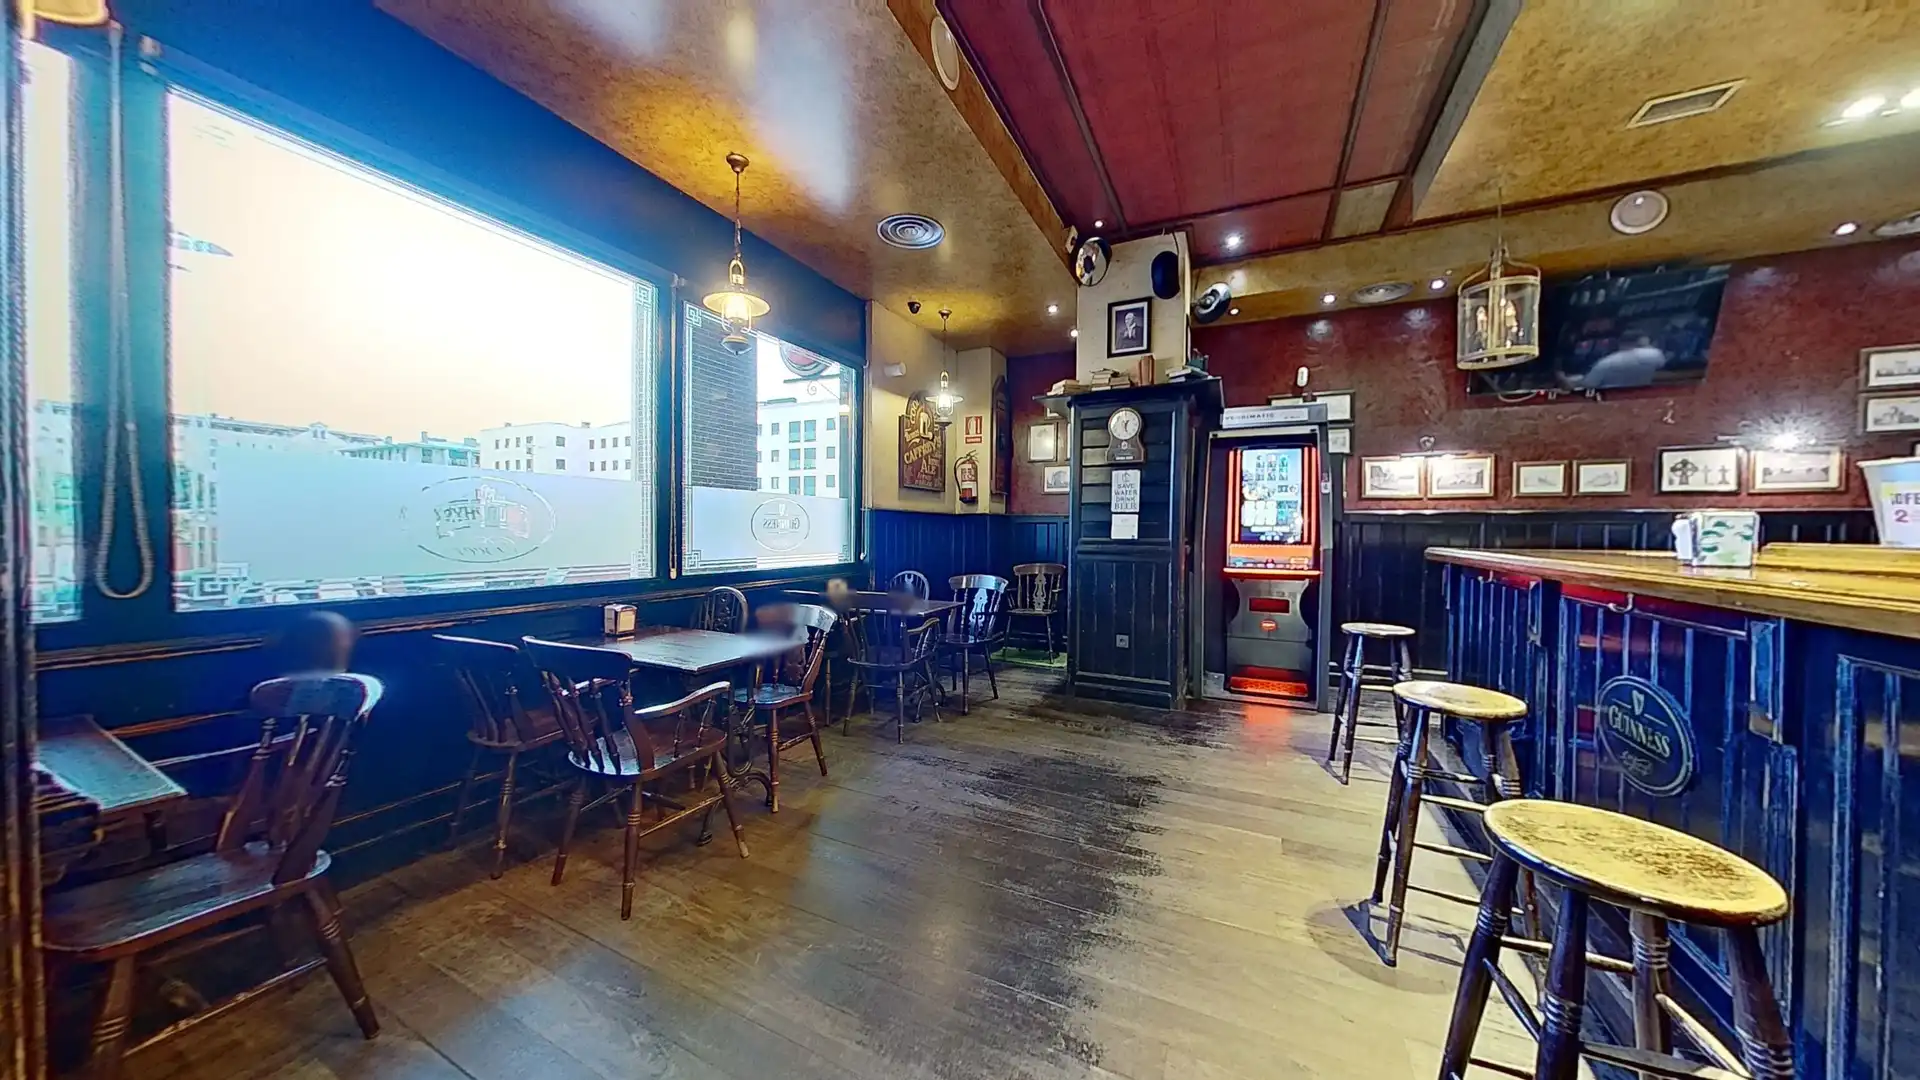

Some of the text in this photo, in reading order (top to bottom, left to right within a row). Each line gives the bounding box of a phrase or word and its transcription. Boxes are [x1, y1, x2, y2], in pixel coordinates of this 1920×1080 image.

[1225, 412, 1274, 420] VEDIMATIC
[1114, 502, 1137, 510] BEER
[1894, 508, 1908, 523] 2
[1608, 705, 1671, 758] GUINNESS
